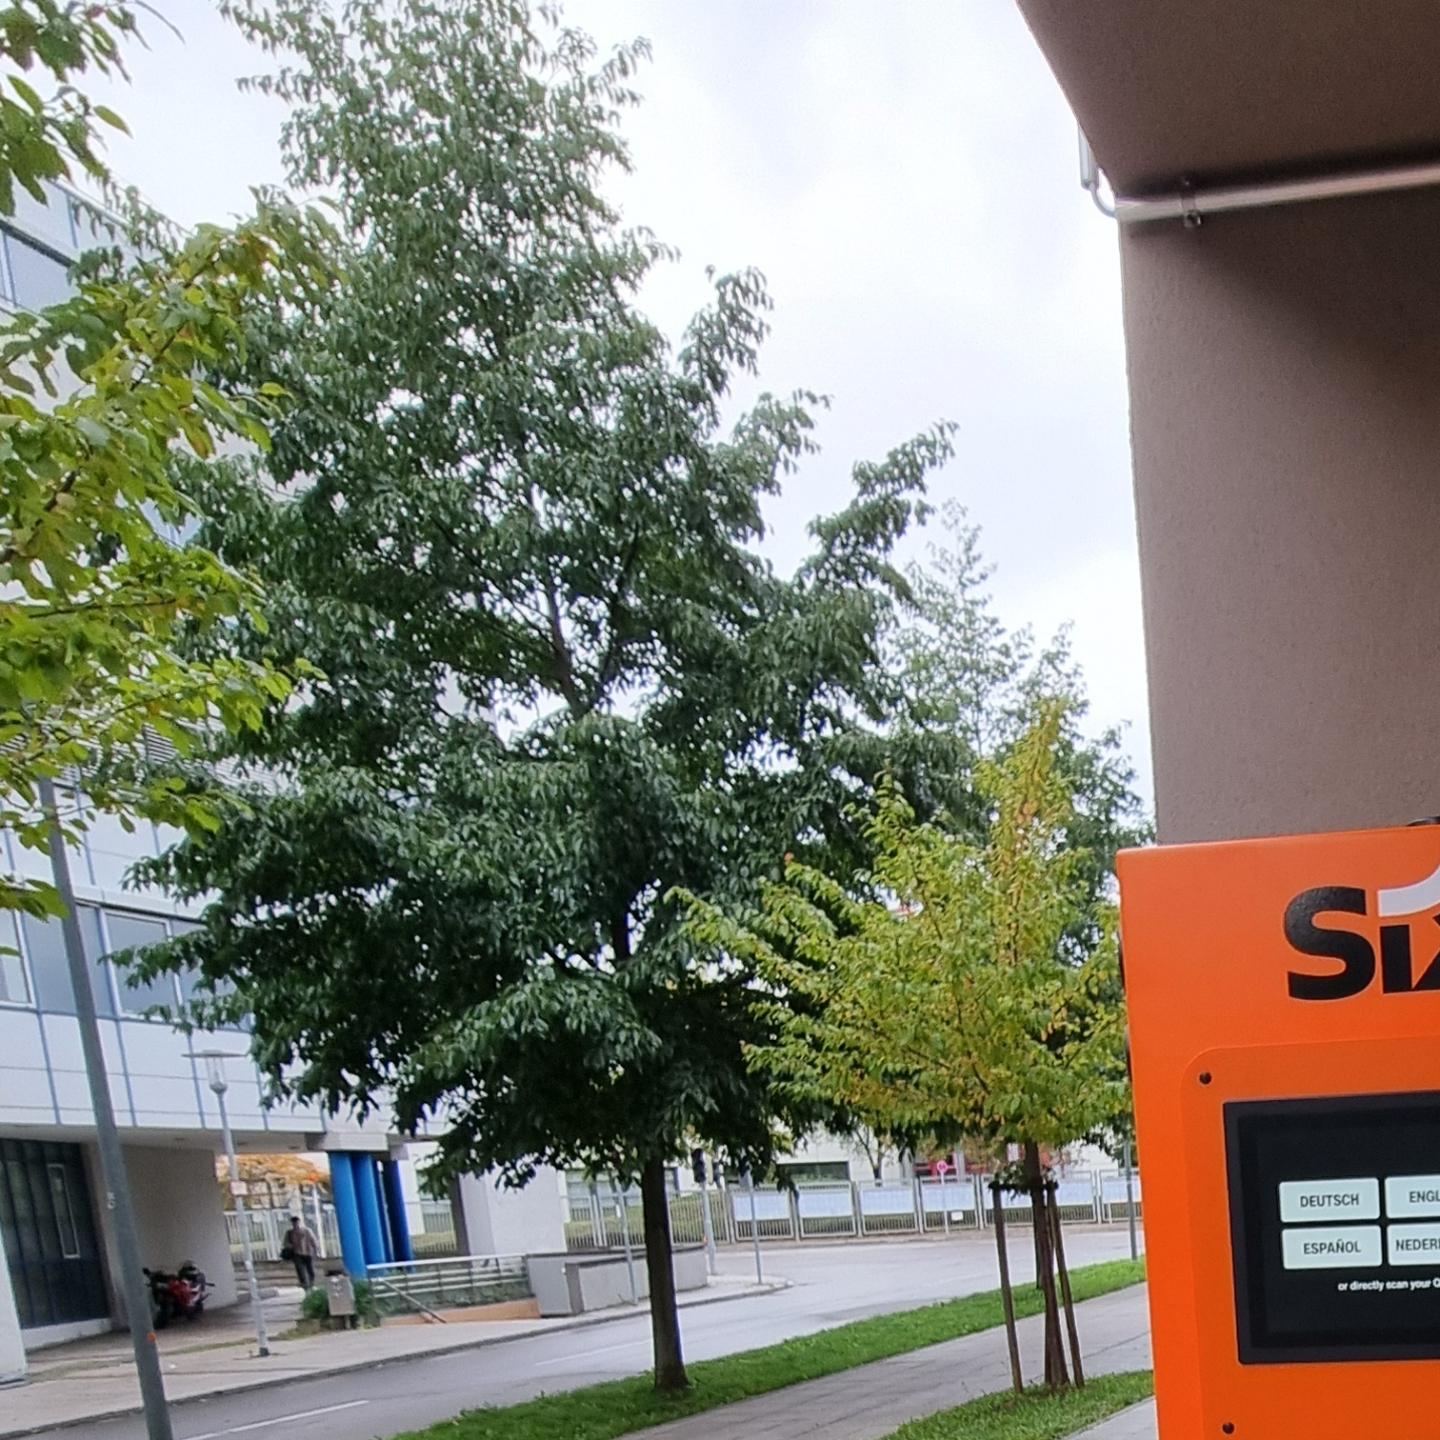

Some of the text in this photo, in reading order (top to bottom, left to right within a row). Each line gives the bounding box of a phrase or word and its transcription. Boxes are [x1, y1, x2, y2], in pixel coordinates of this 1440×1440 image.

[1299, 1193, 1360, 1208] DEUTSCH
[1303, 1238, 1362, 1255] ESPAÑOL
[1337, 1282, 1348, 1291] or
[1350, 1280, 1384, 1292] directly
[1386, 1280, 1409, 1290] scan
[1410, 1280, 1431, 1290] your
